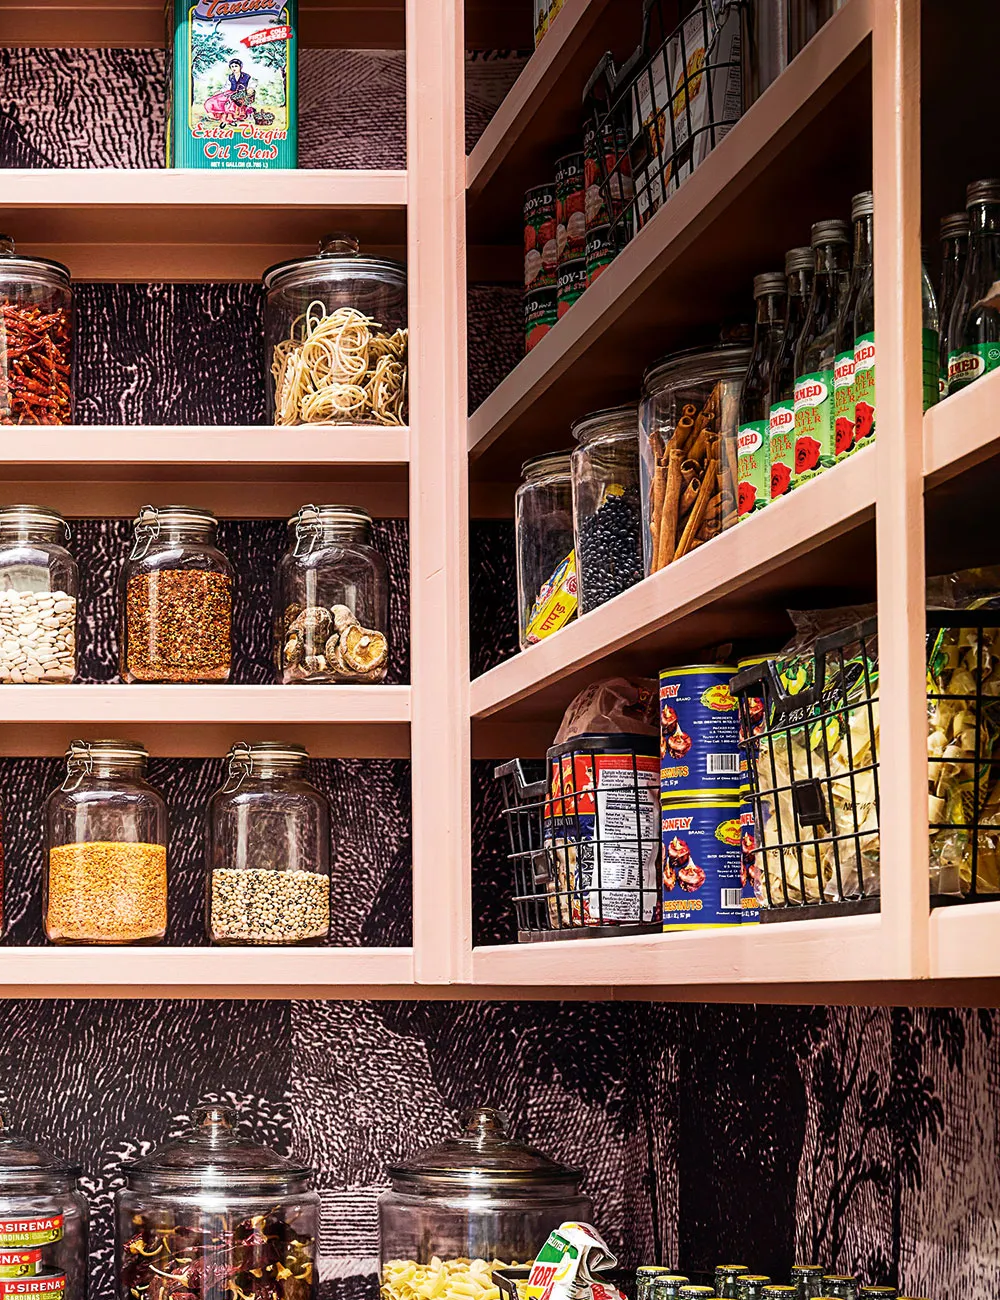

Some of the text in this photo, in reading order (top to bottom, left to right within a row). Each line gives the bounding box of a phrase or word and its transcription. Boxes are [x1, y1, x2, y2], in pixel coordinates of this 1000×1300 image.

[248, 27, 287, 42] FIRST COLD
[192, 122, 287, 144] Extra Virgin
[204, 142, 278, 160] Oil Blend
[5, 1221, 52, 1232] SIRENA
[17, 1281, 61, 1292] SIRENA
